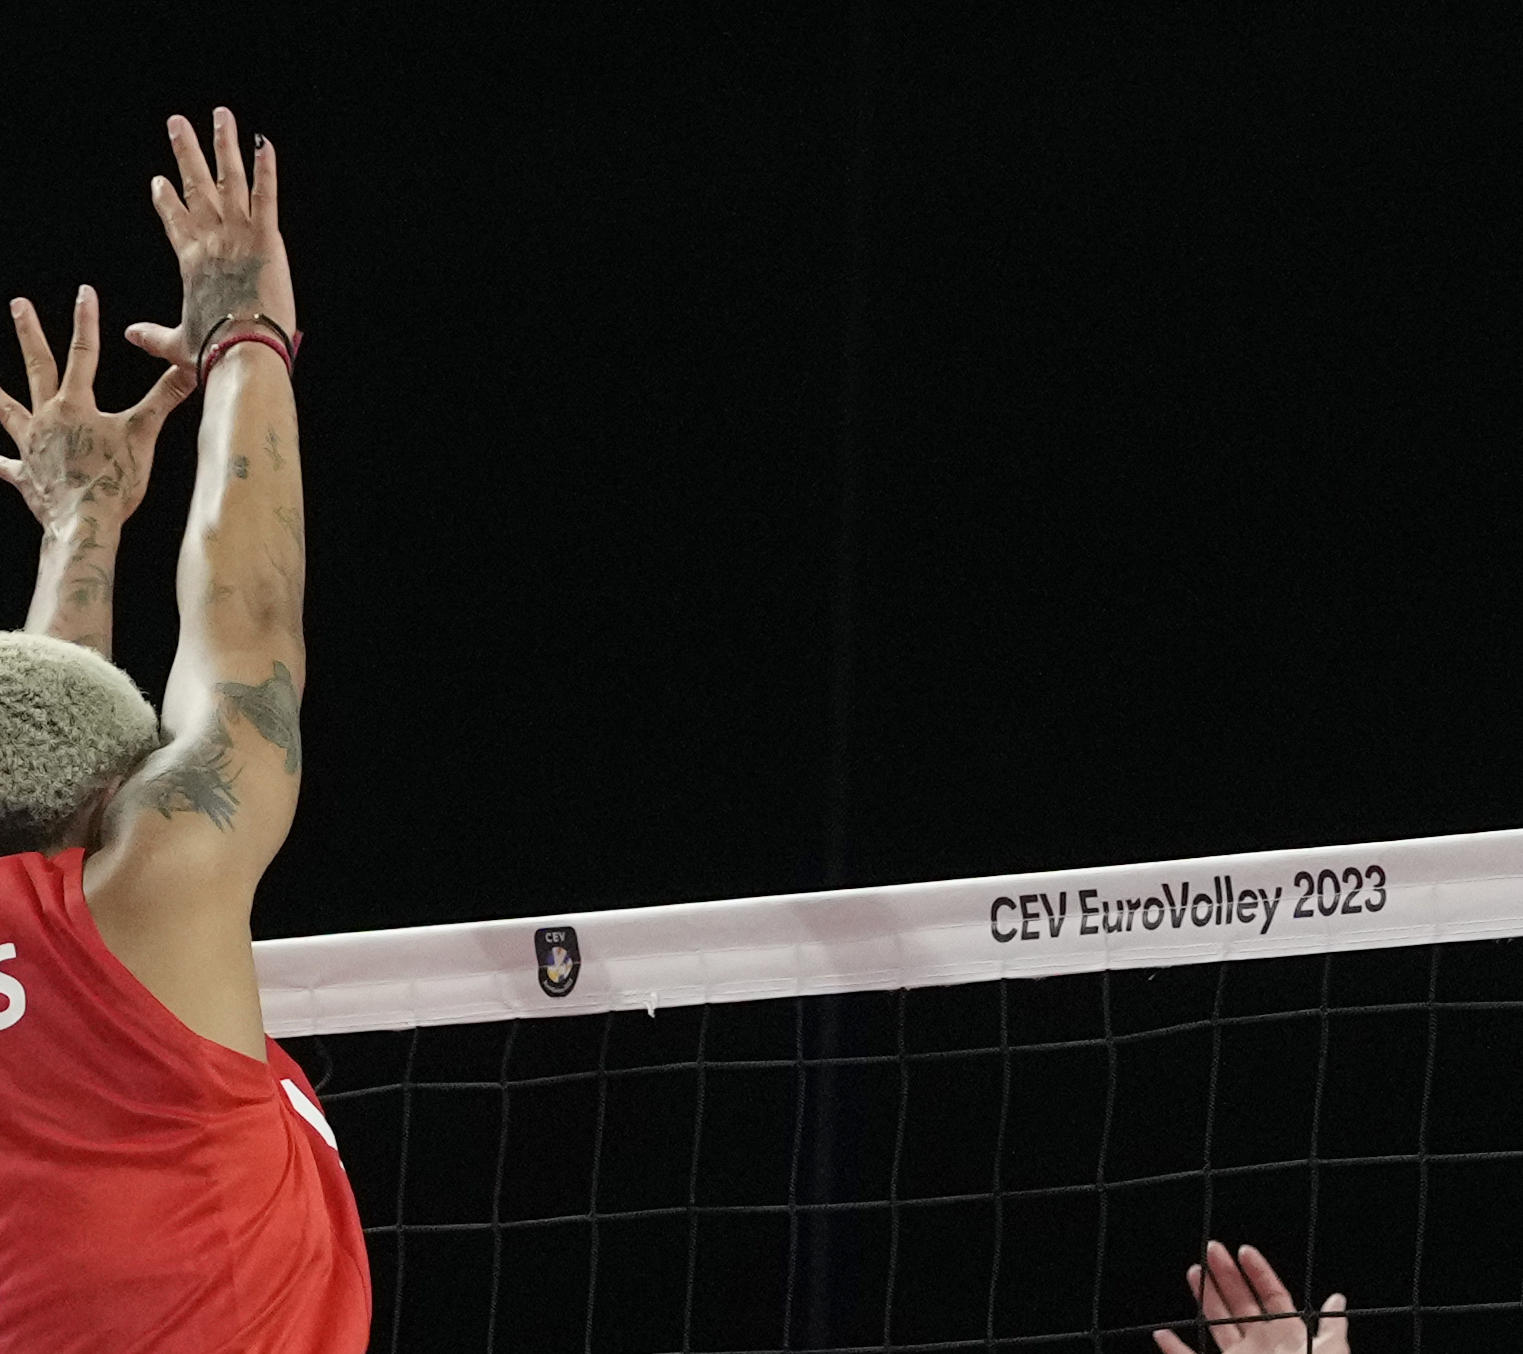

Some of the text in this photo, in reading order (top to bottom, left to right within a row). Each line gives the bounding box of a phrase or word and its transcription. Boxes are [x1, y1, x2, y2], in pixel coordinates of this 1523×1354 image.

[990, 865, 1387, 943] CEV EuroVolley 2023
[545, 931, 566, 943] CEV
